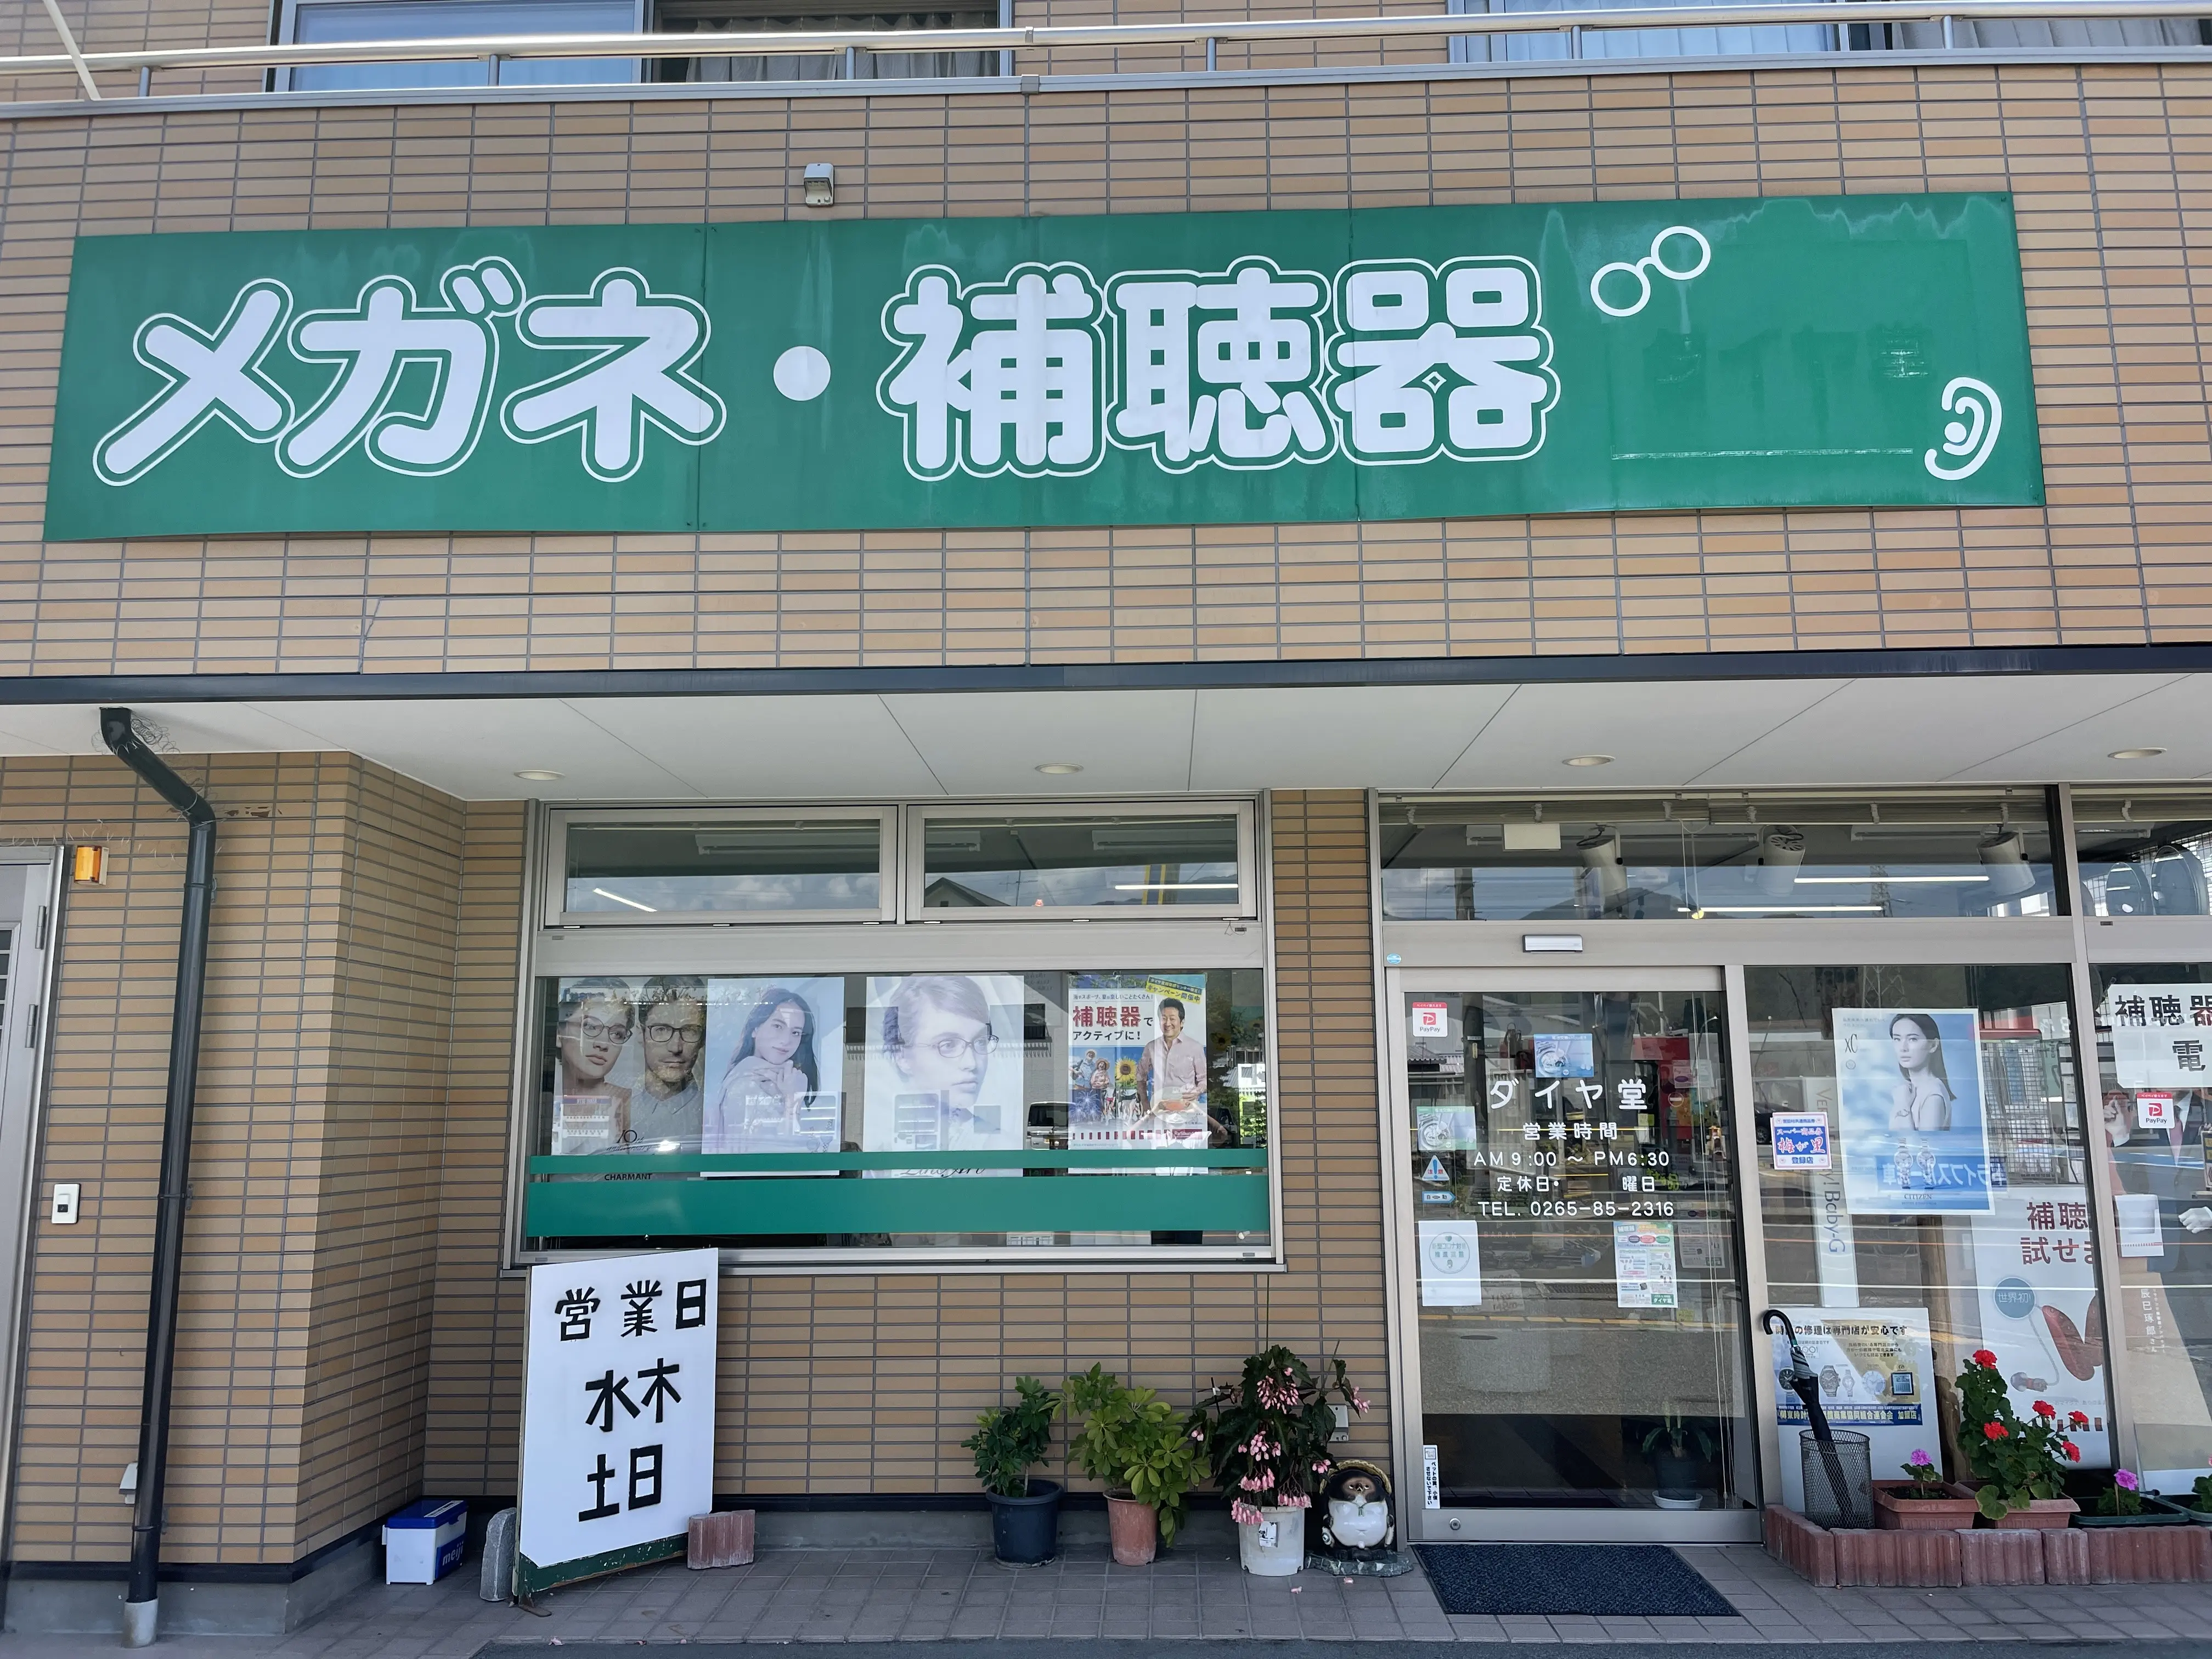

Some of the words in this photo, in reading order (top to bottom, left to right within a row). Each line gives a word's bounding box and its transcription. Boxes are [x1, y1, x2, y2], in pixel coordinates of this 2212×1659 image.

[93, 254, 1561, 483] メガネ・補聴器
[1073, 1006, 1153, 1028] 補聴器で
[2115, 995, 2212, 1026] 補聴器
[1073, 1030, 1141, 1041] アクティブに!
[2172, 1040, 2206, 1071] 電
[1491, 1078, 1647, 1110] ダイヤ堂
[1523, 1122, 1617, 1140] 営業時間
[1777, 1137, 1826, 1154] 梅が里
[1622, 1176, 1655, 1192] 曜日
[1478, 1201, 1521, 1216] TEL.
[1530, 1201, 1674, 1216] 0265-85-2316
[1824, 1190, 1846, 1253] Baby-G
[555, 1279, 707, 1342] 営業日
[1775, 1325, 1908, 1335] 時の修理は専門店が安心です
[585, 1358, 682, 1432] 水木
[578, 1444, 663, 1522] 土日
[442, 1541, 464, 1566] meiji
